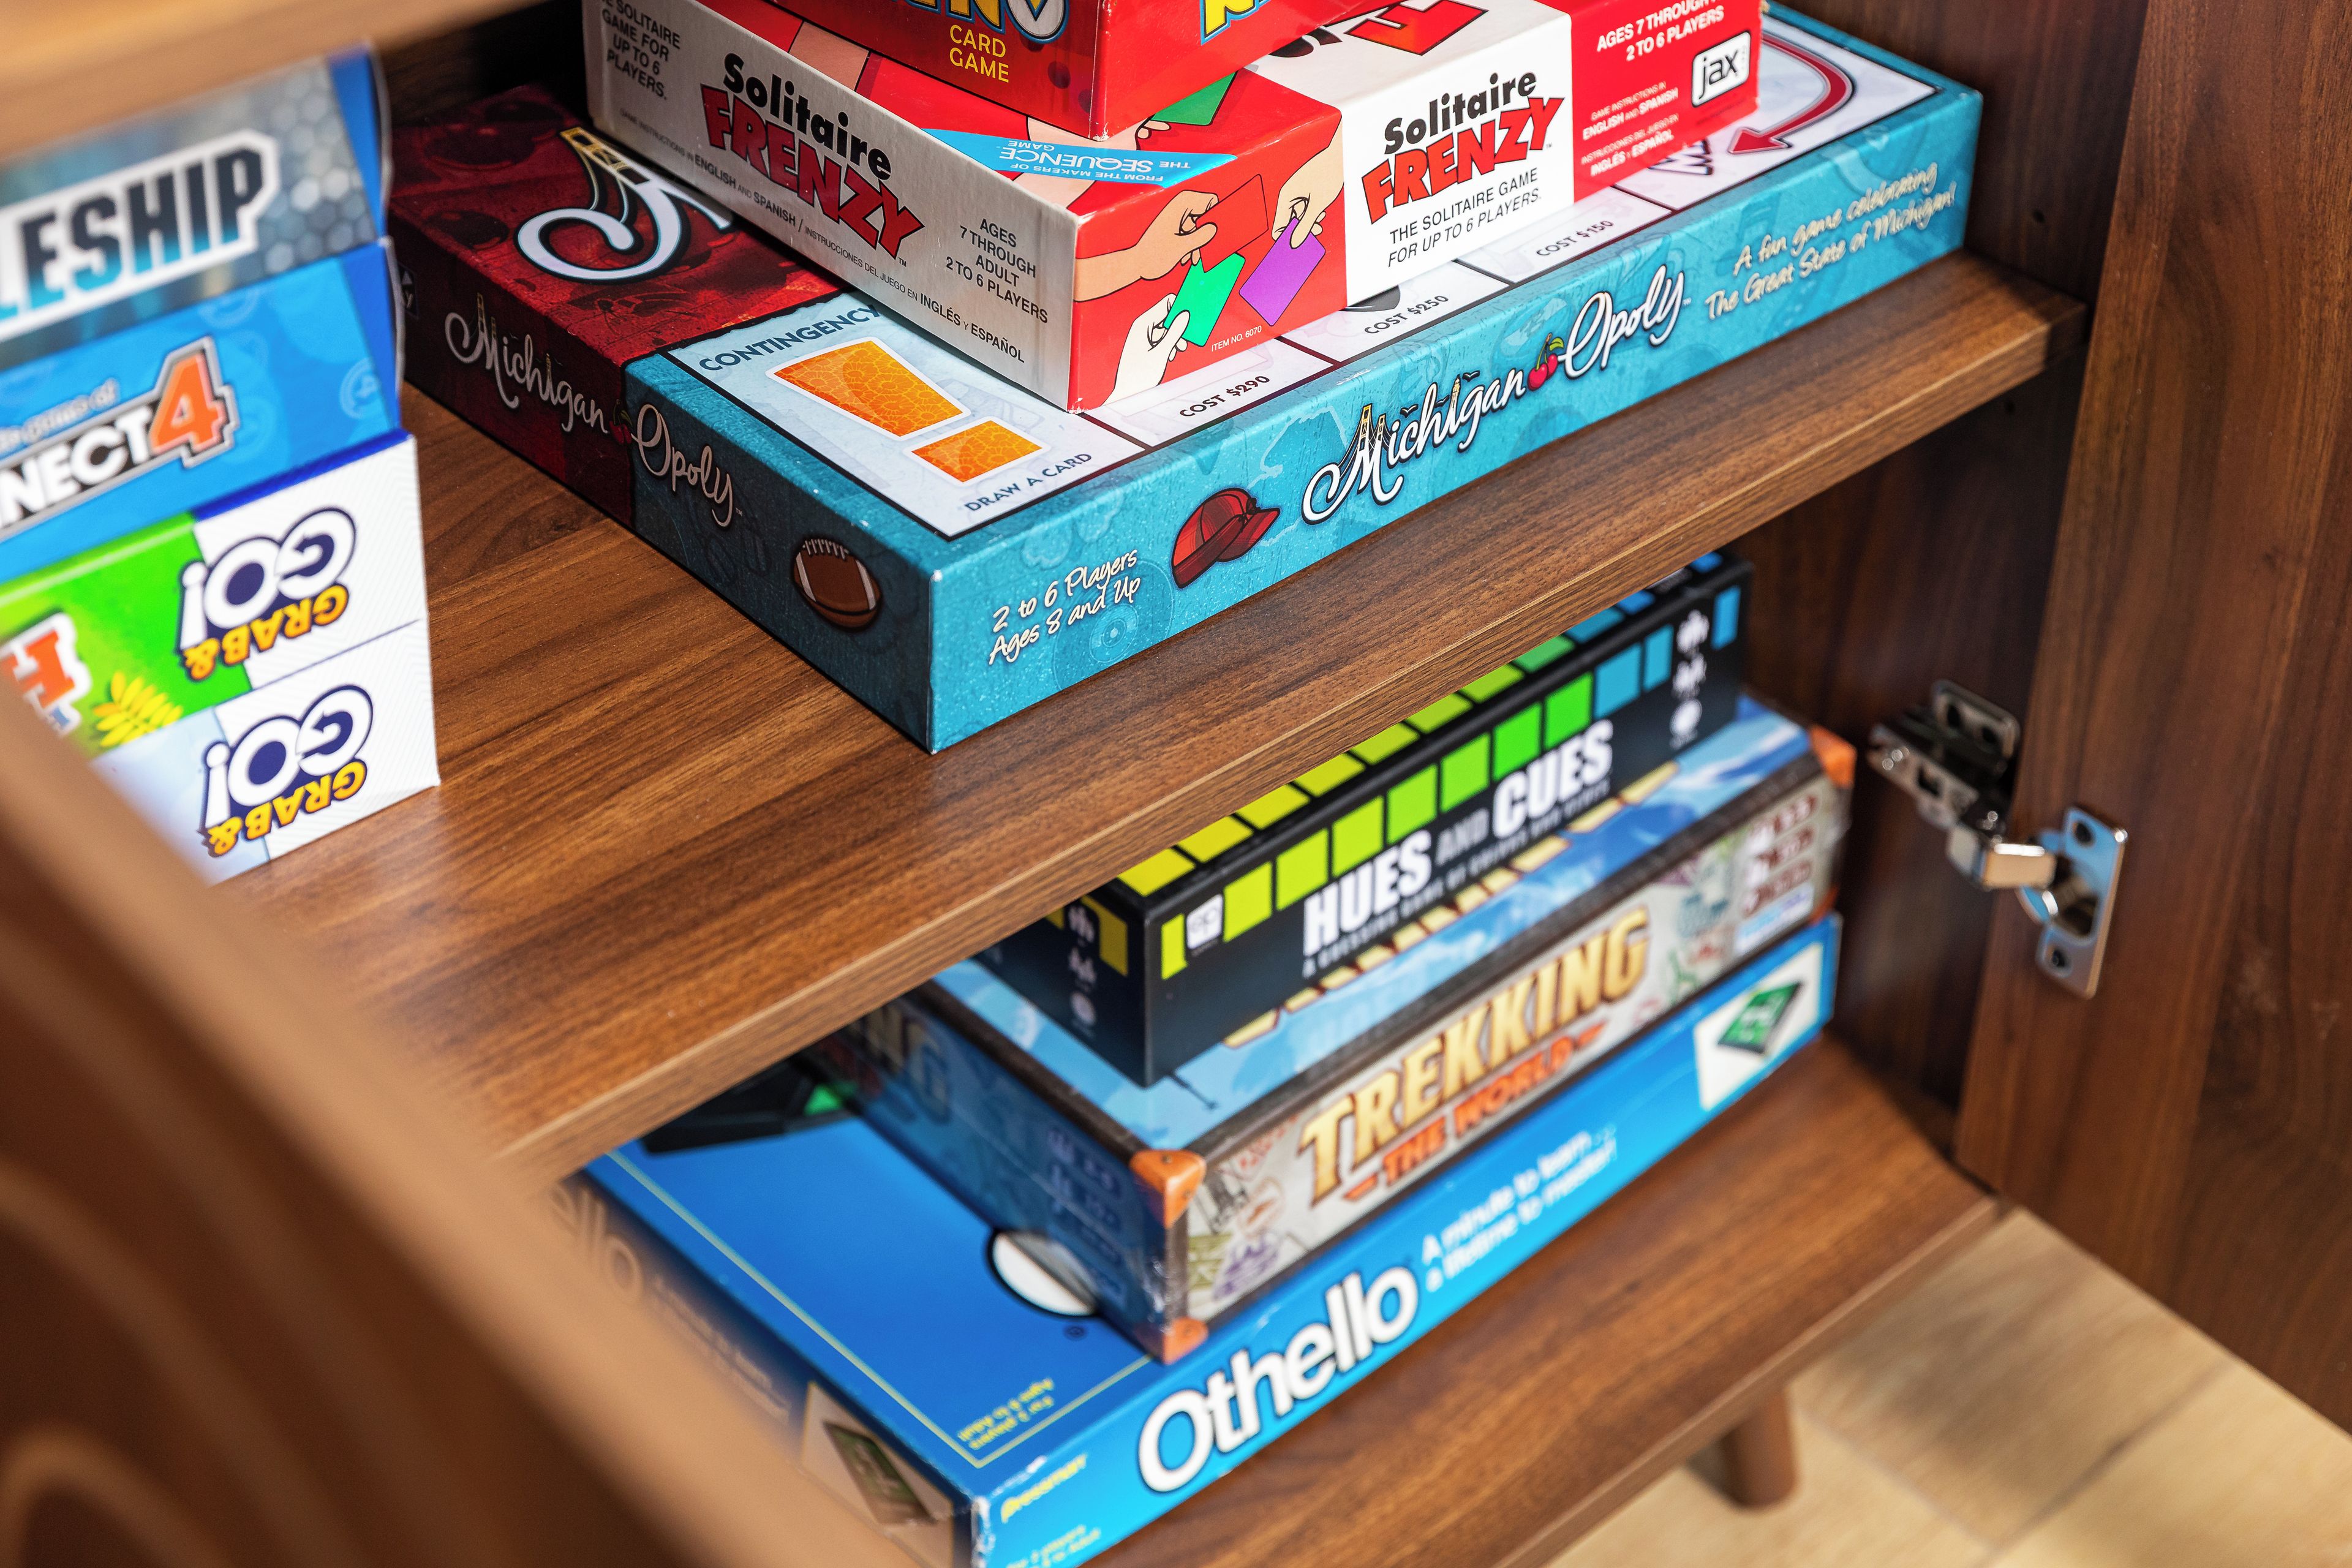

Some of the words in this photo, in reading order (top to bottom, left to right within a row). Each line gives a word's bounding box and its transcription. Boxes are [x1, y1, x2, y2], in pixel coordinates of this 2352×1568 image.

[602, 8, 638, 42] GAME
[642, 33, 669, 62] FOR
[616, 0, 680, 50] SOLITAIRE
[950, 24, 1006, 58] CARD
[1597, 23, 1634, 52] AGES
[1636, 18, 1645, 35] 7
[1626, 45, 1635, 62] 2
[1637, 37, 1654, 56] TO
[1656, 32, 1665, 48] 6
[1667, 5, 1725, 43] PLAYERS
[607, 49, 667, 100] PLAYERS.
[613, 34, 630, 54] UP
[632, 45, 649, 68] TO
[652, 61, 660, 75] 6
[950, 47, 1009, 83] GAME
[1699, 50, 1739, 100] jax
[723, 53, 892, 181] Solitaire
[1384, 71, 1537, 155] Solitaire
[1583, 111, 1624, 141] ENGLISH
[1638, 87, 1679, 115] SPANISH
[699, 83, 925, 260] FRENZY
[999, 146, 1155, 173] SEQUENCE
[1008, 140, 1055, 151] GAME
[1033, 166, 1092, 178] MAKERS
[1159, 160, 1191, 169] THE
[1361, 96, 1566, 225] FRENZY
[1590, 149, 1626, 176] INGLÉS
[1631, 129, 1675, 159] ESPAÑOL
[1124, 173, 1164, 182] FROM
[1390, 221, 1419, 244] THE
[1422, 187, 1495, 233] SOLITAIRE
[1498, 167, 1539, 197] GAME
[695, 151, 736, 189] ENGLISH
[753, 191, 796, 227] SPANISH
[805, 225, 863, 268] INSTRUCCIONES
[864, 262, 880, 279] DEL
[880, 273, 906, 293] JUEGO
[907, 288, 918, 301] EN
[920, 292, 961, 326] INGLÉS
[963, 321, 969, 331] Y
[971, 323, 1025, 363] ESPAÑOL
[960, 225, 968, 239] 7
[970, 230, 1037, 278] THROUGH
[980, 218, 1017, 248] AGES
[1387, 241, 1418, 268] FOR
[1422, 233, 1441, 252] UP
[1446, 223, 1462, 243] TO
[1466, 217, 1474, 233] 6
[1536, 235, 1578, 257] COST
[1575, 219, 1615, 238] $150
[946, 255, 954, 271] 2
[955, 261, 973, 281] TO
[976, 273, 984, 288] 6
[987, 279, 1049, 323] PLAYERS
[975, 254, 1020, 287] ADULT
[1364, 312, 1410, 335] COST
[1407, 295, 1449, 316] $250
[1705, 289, 1740, 320] The
[699, 304, 881, 371] CONTINGENCY
[1211, 337, 1230, 352] ITEM
[1231, 332, 1244, 345] NO.
[1245, 325, 1262, 340] 6070
[445, 293, 609, 435] Michigan
[631, 402, 735, 529] Opoly
[1180, 394, 1229, 418] COST
[1226, 375, 1270, 397] $290
[1300, 369, 1526, 525] Michigan
[1558, 263, 1685, 380] Opoly
[964, 483, 1022, 511] DRAW
[1027, 477, 1043, 486] A
[1042, 453, 1093, 478] CARD
[178, 507, 356, 652] GO!
[992, 605, 1010, 633] 2
[1017, 597, 1038, 619] to
[1044, 580, 1059, 608] 6
[1064, 548, 1138, 597] Players
[989, 624, 1041, 666] Ages
[1046, 607, 1063, 635] 8
[1068, 583, 1107, 626] and
[1113, 575, 1142, 604] Up
[205, 684, 374, 828] GO!
[1303, 829, 1432, 958] HUES
[1436, 807, 1490, 867] AND
[1493, 718, 1614, 839] CUES
[1296, 904, 1651, 1210] TREKKING
[1382, 1116, 1447, 1186] THE
[1453, 1036, 1575, 1138] WORLD
[1138, 1266, 1419, 1493] Othello
